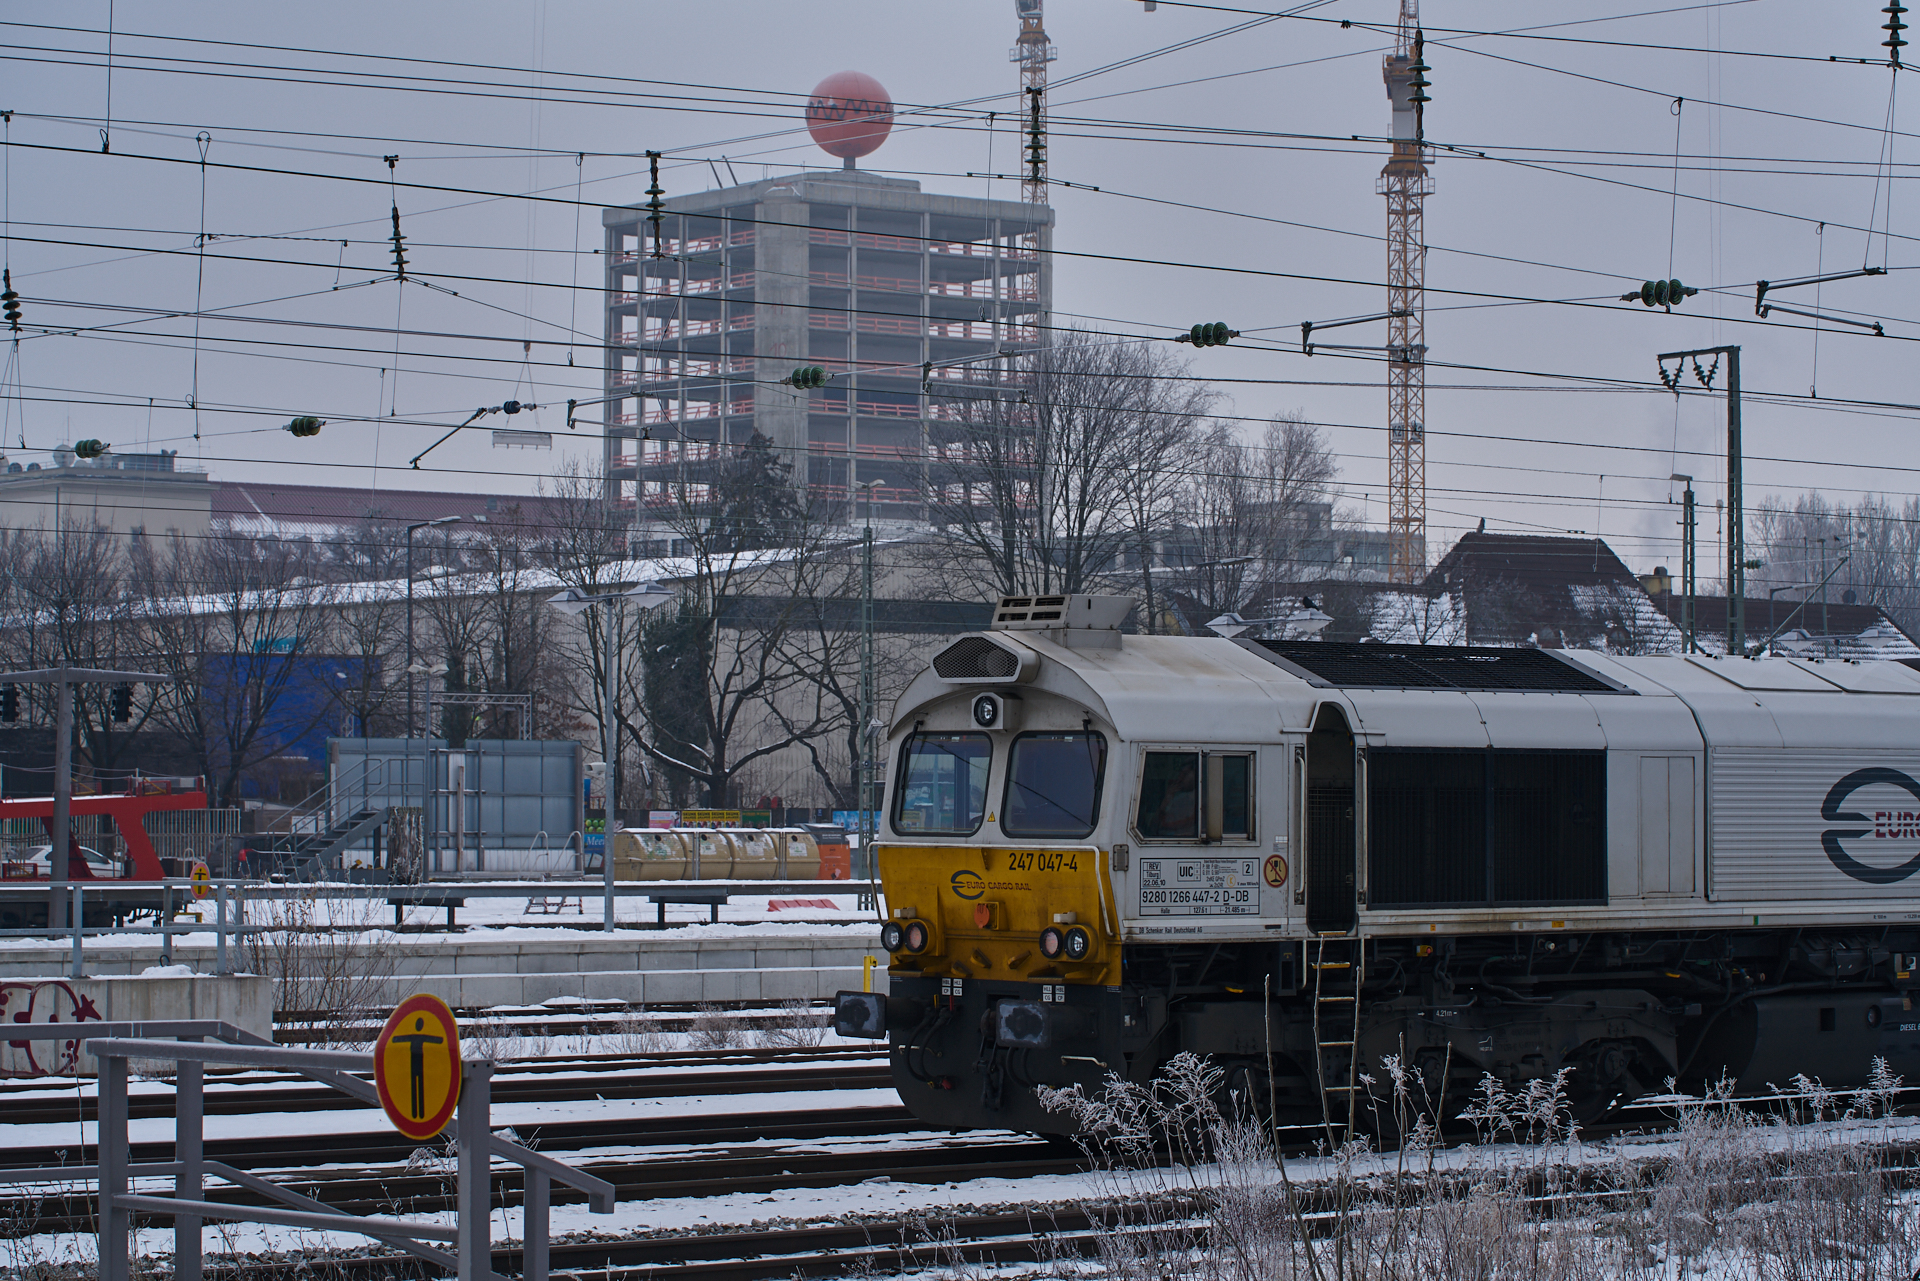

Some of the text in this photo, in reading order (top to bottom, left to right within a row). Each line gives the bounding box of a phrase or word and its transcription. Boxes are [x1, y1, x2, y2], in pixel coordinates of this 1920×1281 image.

[1009, 853, 1078, 872] 247 047-4
[1179, 866, 1194, 877] UIC
[1245, 863, 1251, 874] 2
[966, 881, 1032, 891] EURO CARGO RAIL
[1142, 890, 1250, 903] 9280 1266 447-2 D-DB
[1899, 1023, 1917, 1032] DIESEL
